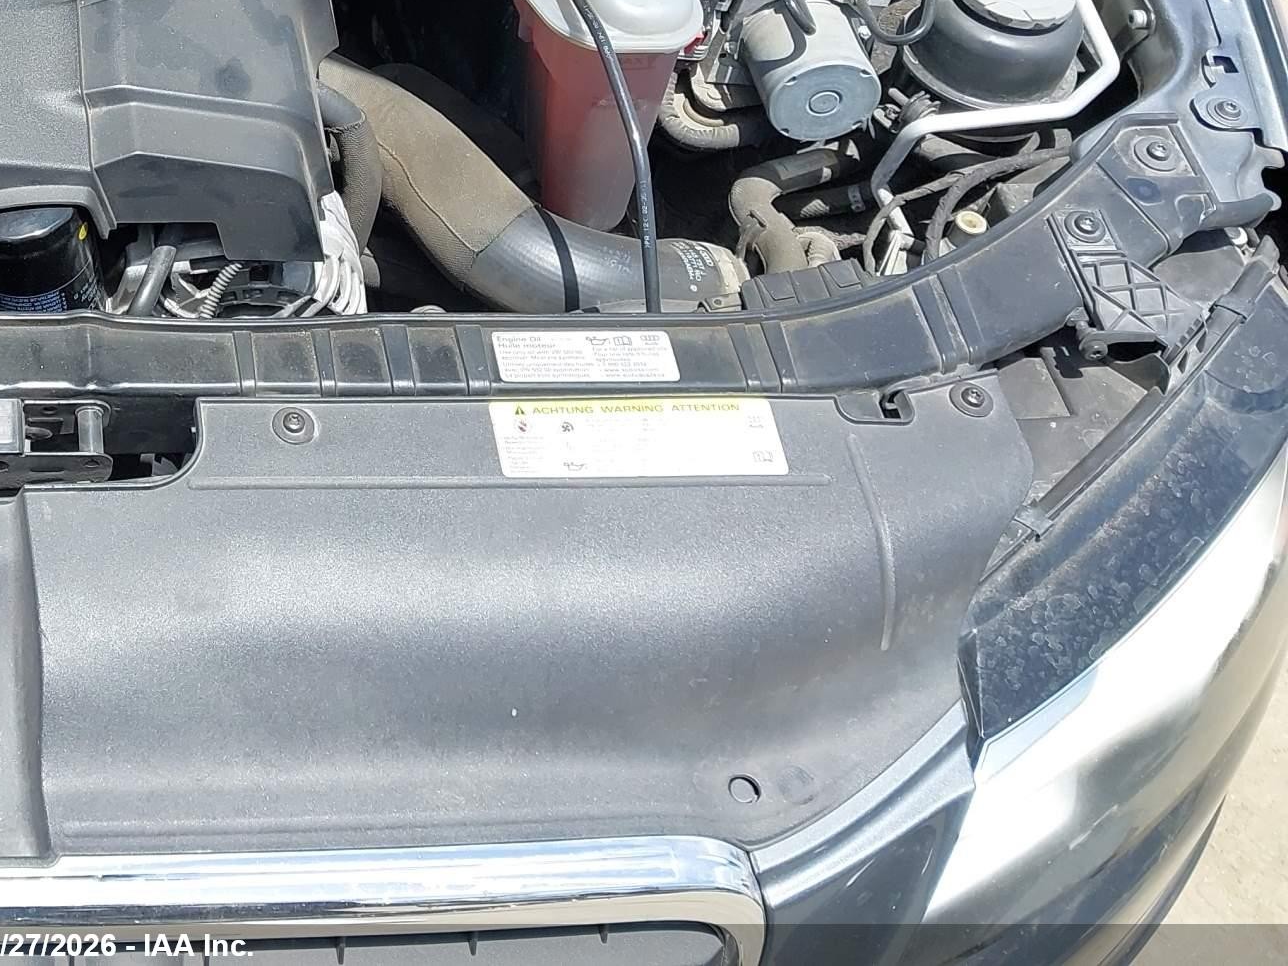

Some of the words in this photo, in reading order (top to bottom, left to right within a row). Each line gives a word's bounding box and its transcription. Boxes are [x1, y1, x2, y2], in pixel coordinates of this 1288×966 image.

[532, 405, 594, 415] ACHTUNG
[600, 404, 664, 414] WARNING
[672, 403, 740, 412] ATTENTION
